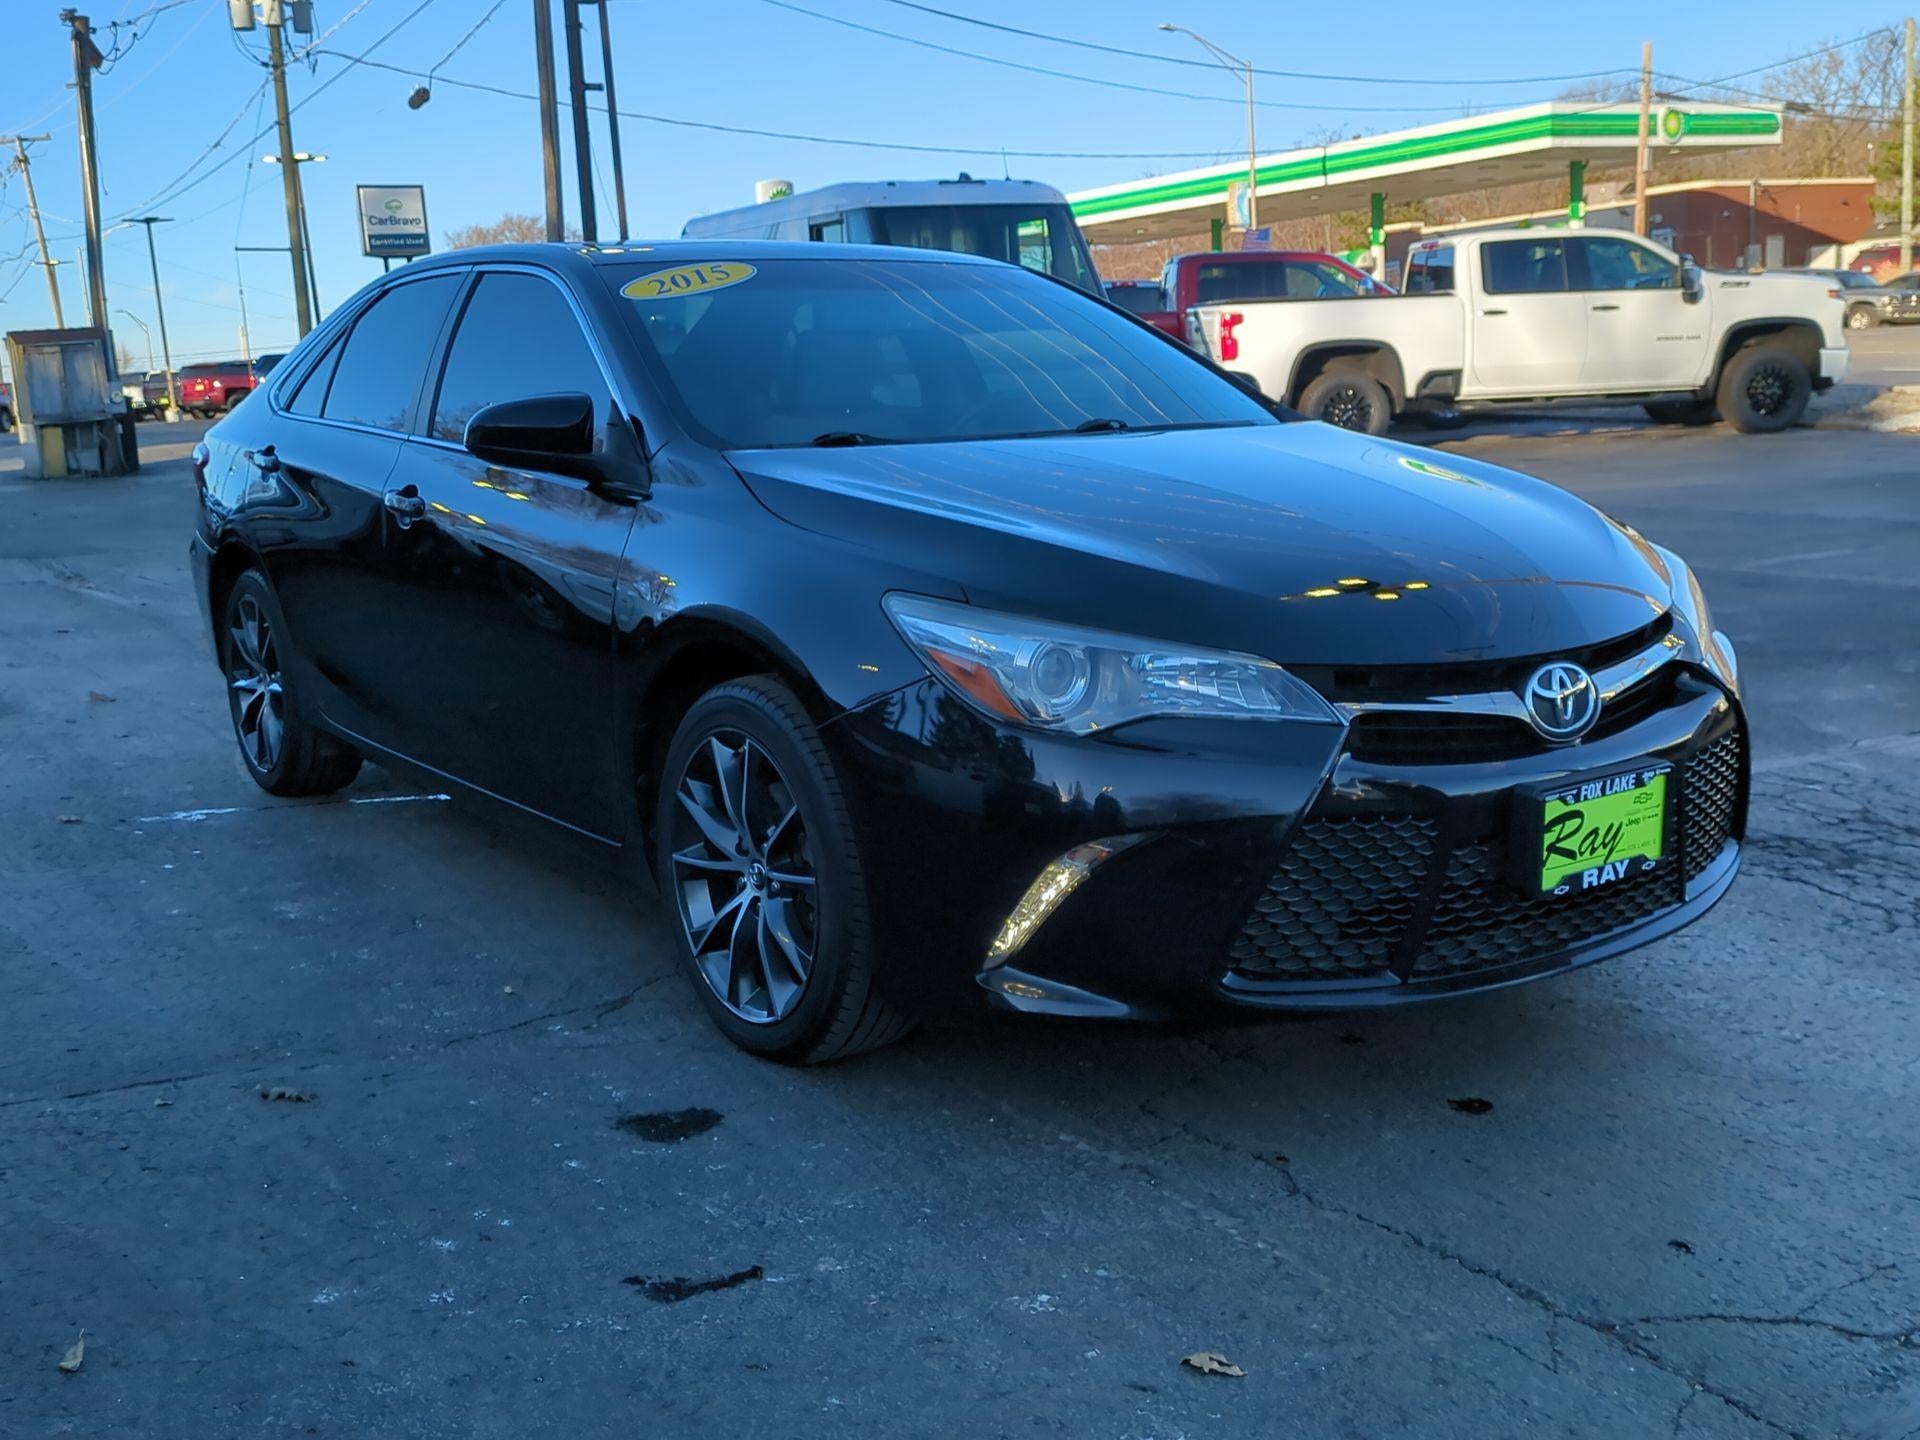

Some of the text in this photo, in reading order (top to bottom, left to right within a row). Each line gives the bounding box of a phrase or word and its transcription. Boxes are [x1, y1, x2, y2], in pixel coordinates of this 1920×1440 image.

[369, 215, 421, 226] CarBravo
[648, 264, 730, 295] 2015
[1580, 782, 1603, 801] FOX
[1605, 774, 1636, 795] LAKE
[1543, 809, 1625, 867] Ray
[1582, 859, 1630, 889] RAY
